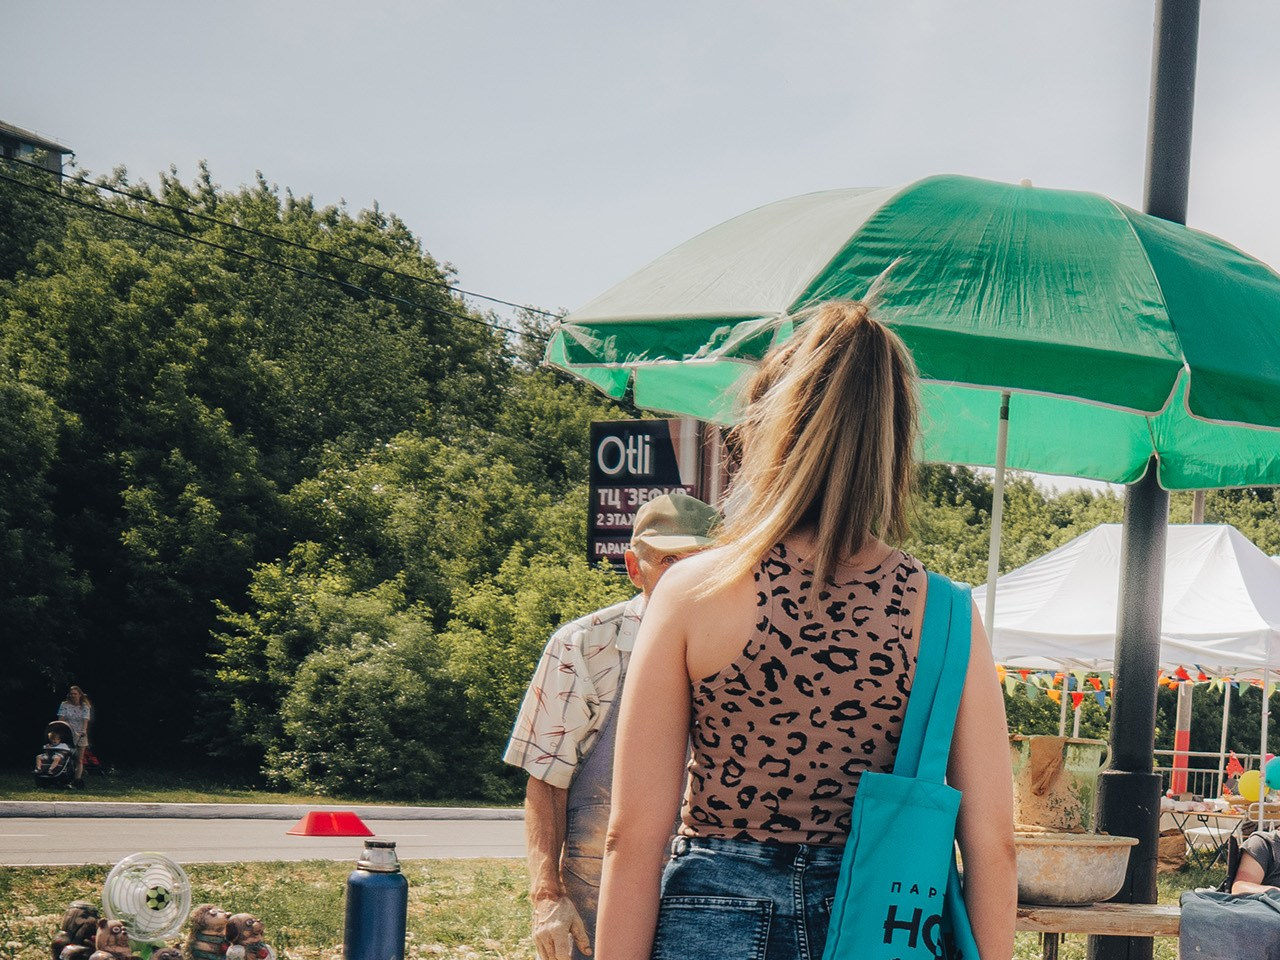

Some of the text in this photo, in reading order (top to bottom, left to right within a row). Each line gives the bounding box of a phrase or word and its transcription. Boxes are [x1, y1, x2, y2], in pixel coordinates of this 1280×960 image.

[597, 435, 651, 475] Otli
[598, 488, 620, 509] ТЦ
[597, 513, 604, 526] 2
[595, 543, 631, 555] ГАРАН
[890, 881, 946, 899] ПАР
